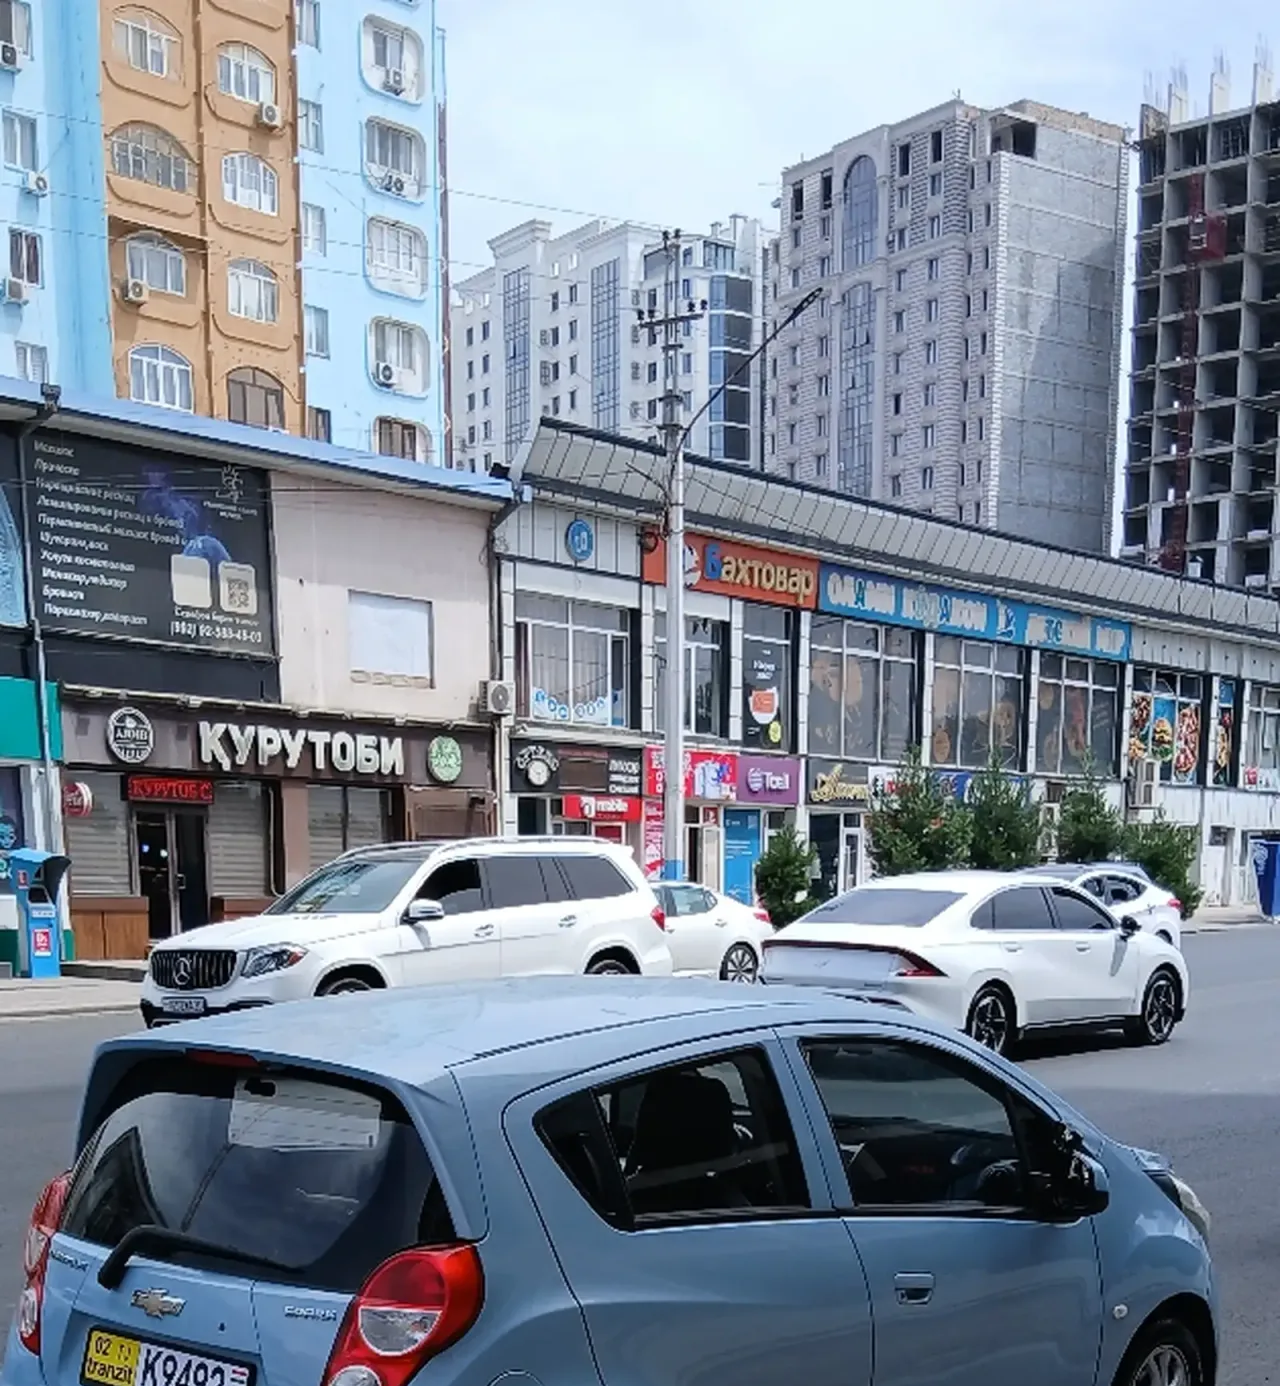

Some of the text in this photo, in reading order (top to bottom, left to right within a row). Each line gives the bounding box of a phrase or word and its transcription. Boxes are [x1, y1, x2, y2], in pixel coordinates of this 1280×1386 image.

[199, 720, 405, 776] ҚУРУТОБИ
[95, 1336, 111, 1357] 02
[87, 1356, 133, 1384] tranzit
